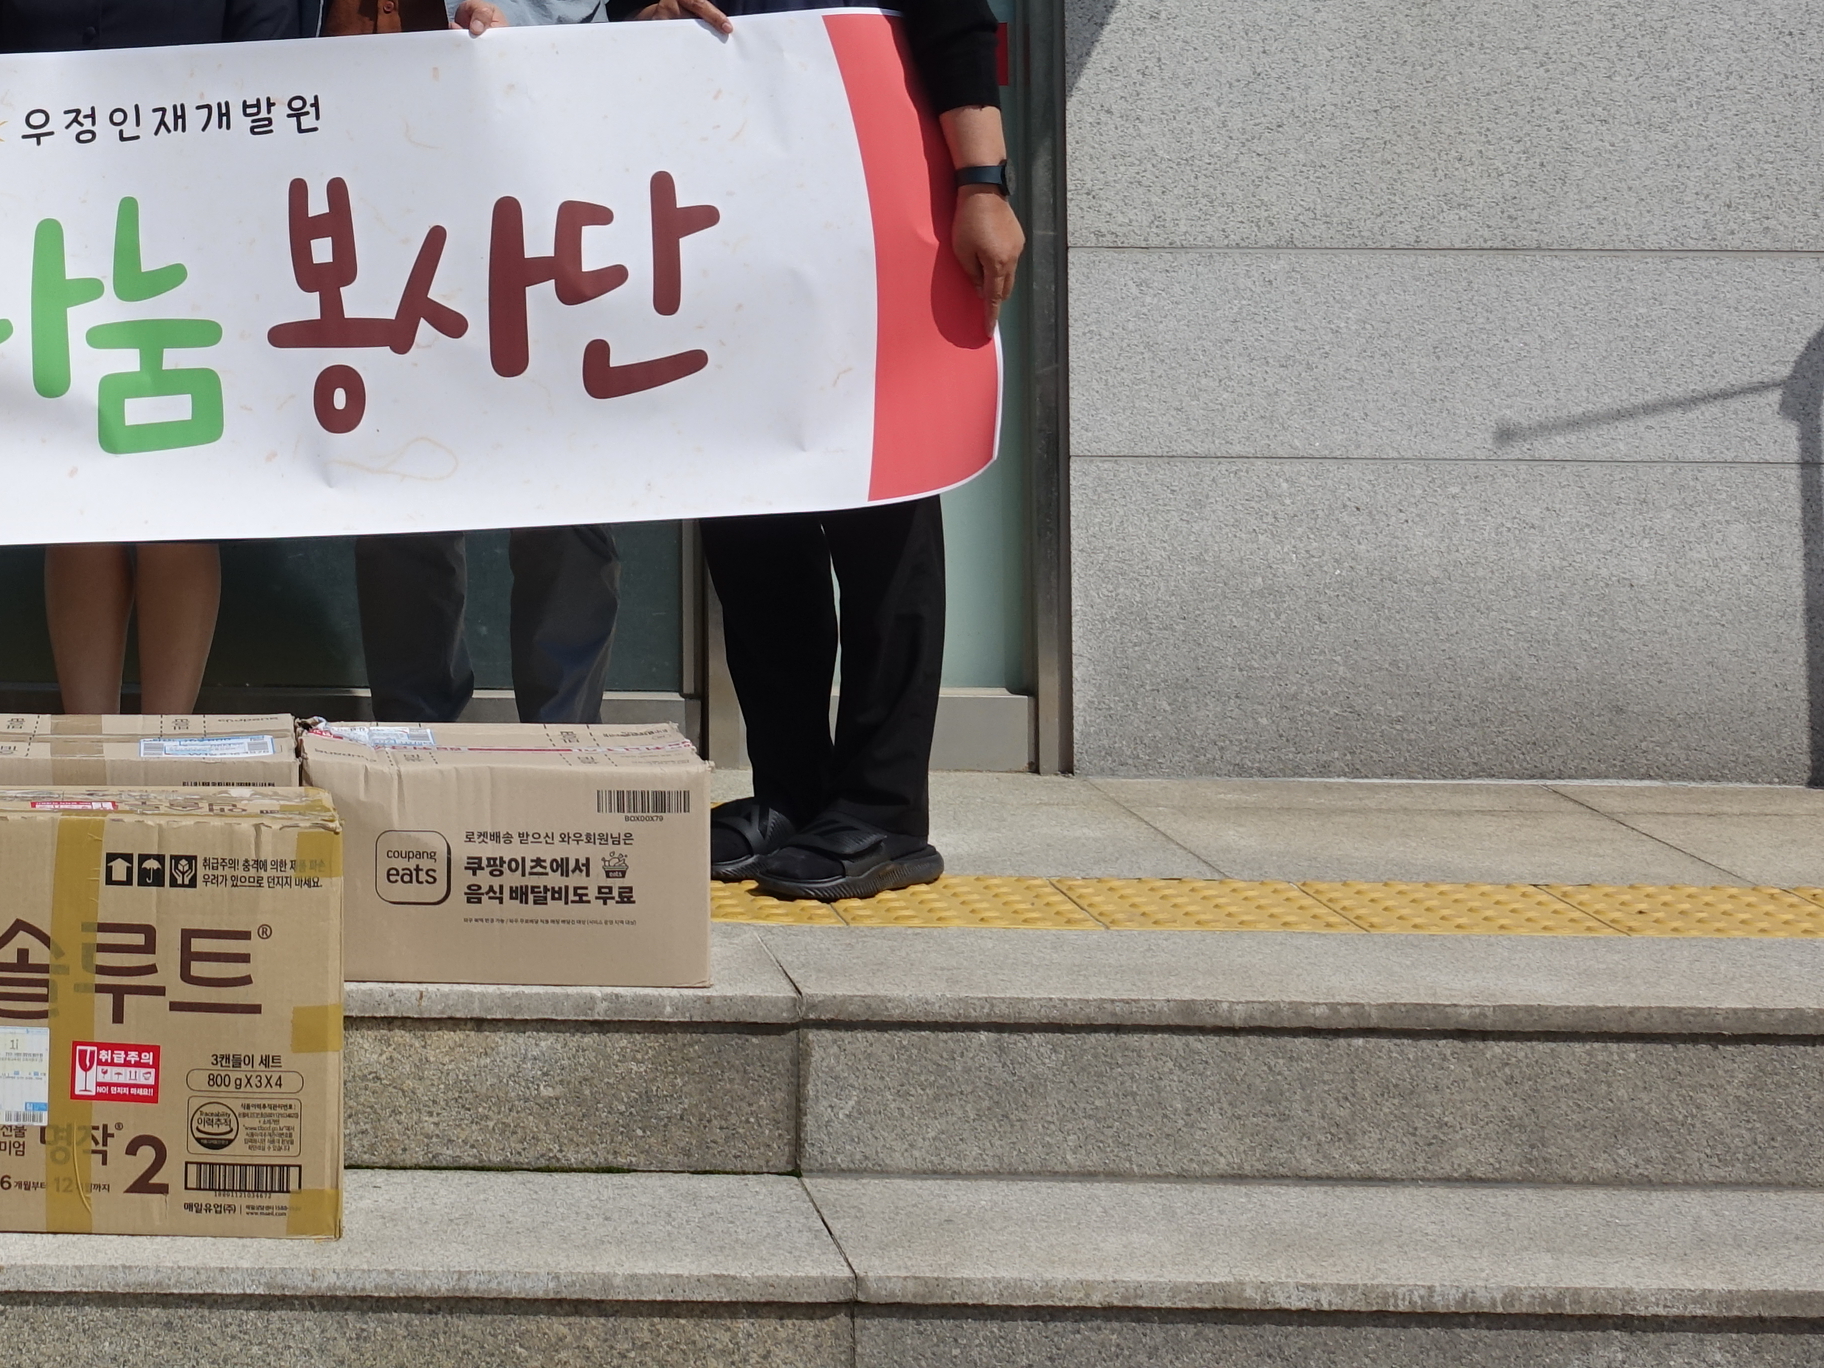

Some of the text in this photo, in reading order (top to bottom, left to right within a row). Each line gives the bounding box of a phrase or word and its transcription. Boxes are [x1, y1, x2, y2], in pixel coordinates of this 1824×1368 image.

[20, 94, 323, 147] 우정인재개발원
[267, 170, 721, 435] 봉사단
[464, 831, 635, 846] 로켓배송 받으신 와우회원님은
[386, 848, 437, 863] coupang
[202, 857, 239, 871] 취급주의!
[242, 858, 267, 872] 충격에
[270, 859, 287, 872] 의한
[464, 856, 591, 878] 쿠팡이츠에서
[202, 874, 323, 889] 우려가 있으므로 던지지 마세요.
[386, 864, 437, 885] eats
[464, 884, 636, 906] 음식 배달비도 무료
[99, 1049, 154, 1065] 취급주의
[211, 1054, 283, 1068] 3캔들이 세트
[110, 1086, 129, 1095] 던지지
[197, 1117, 232, 1129] 이력추적
[123, 1134, 169, 1195] 2
[184, 1202, 236, 1214] 매일유업(주)
